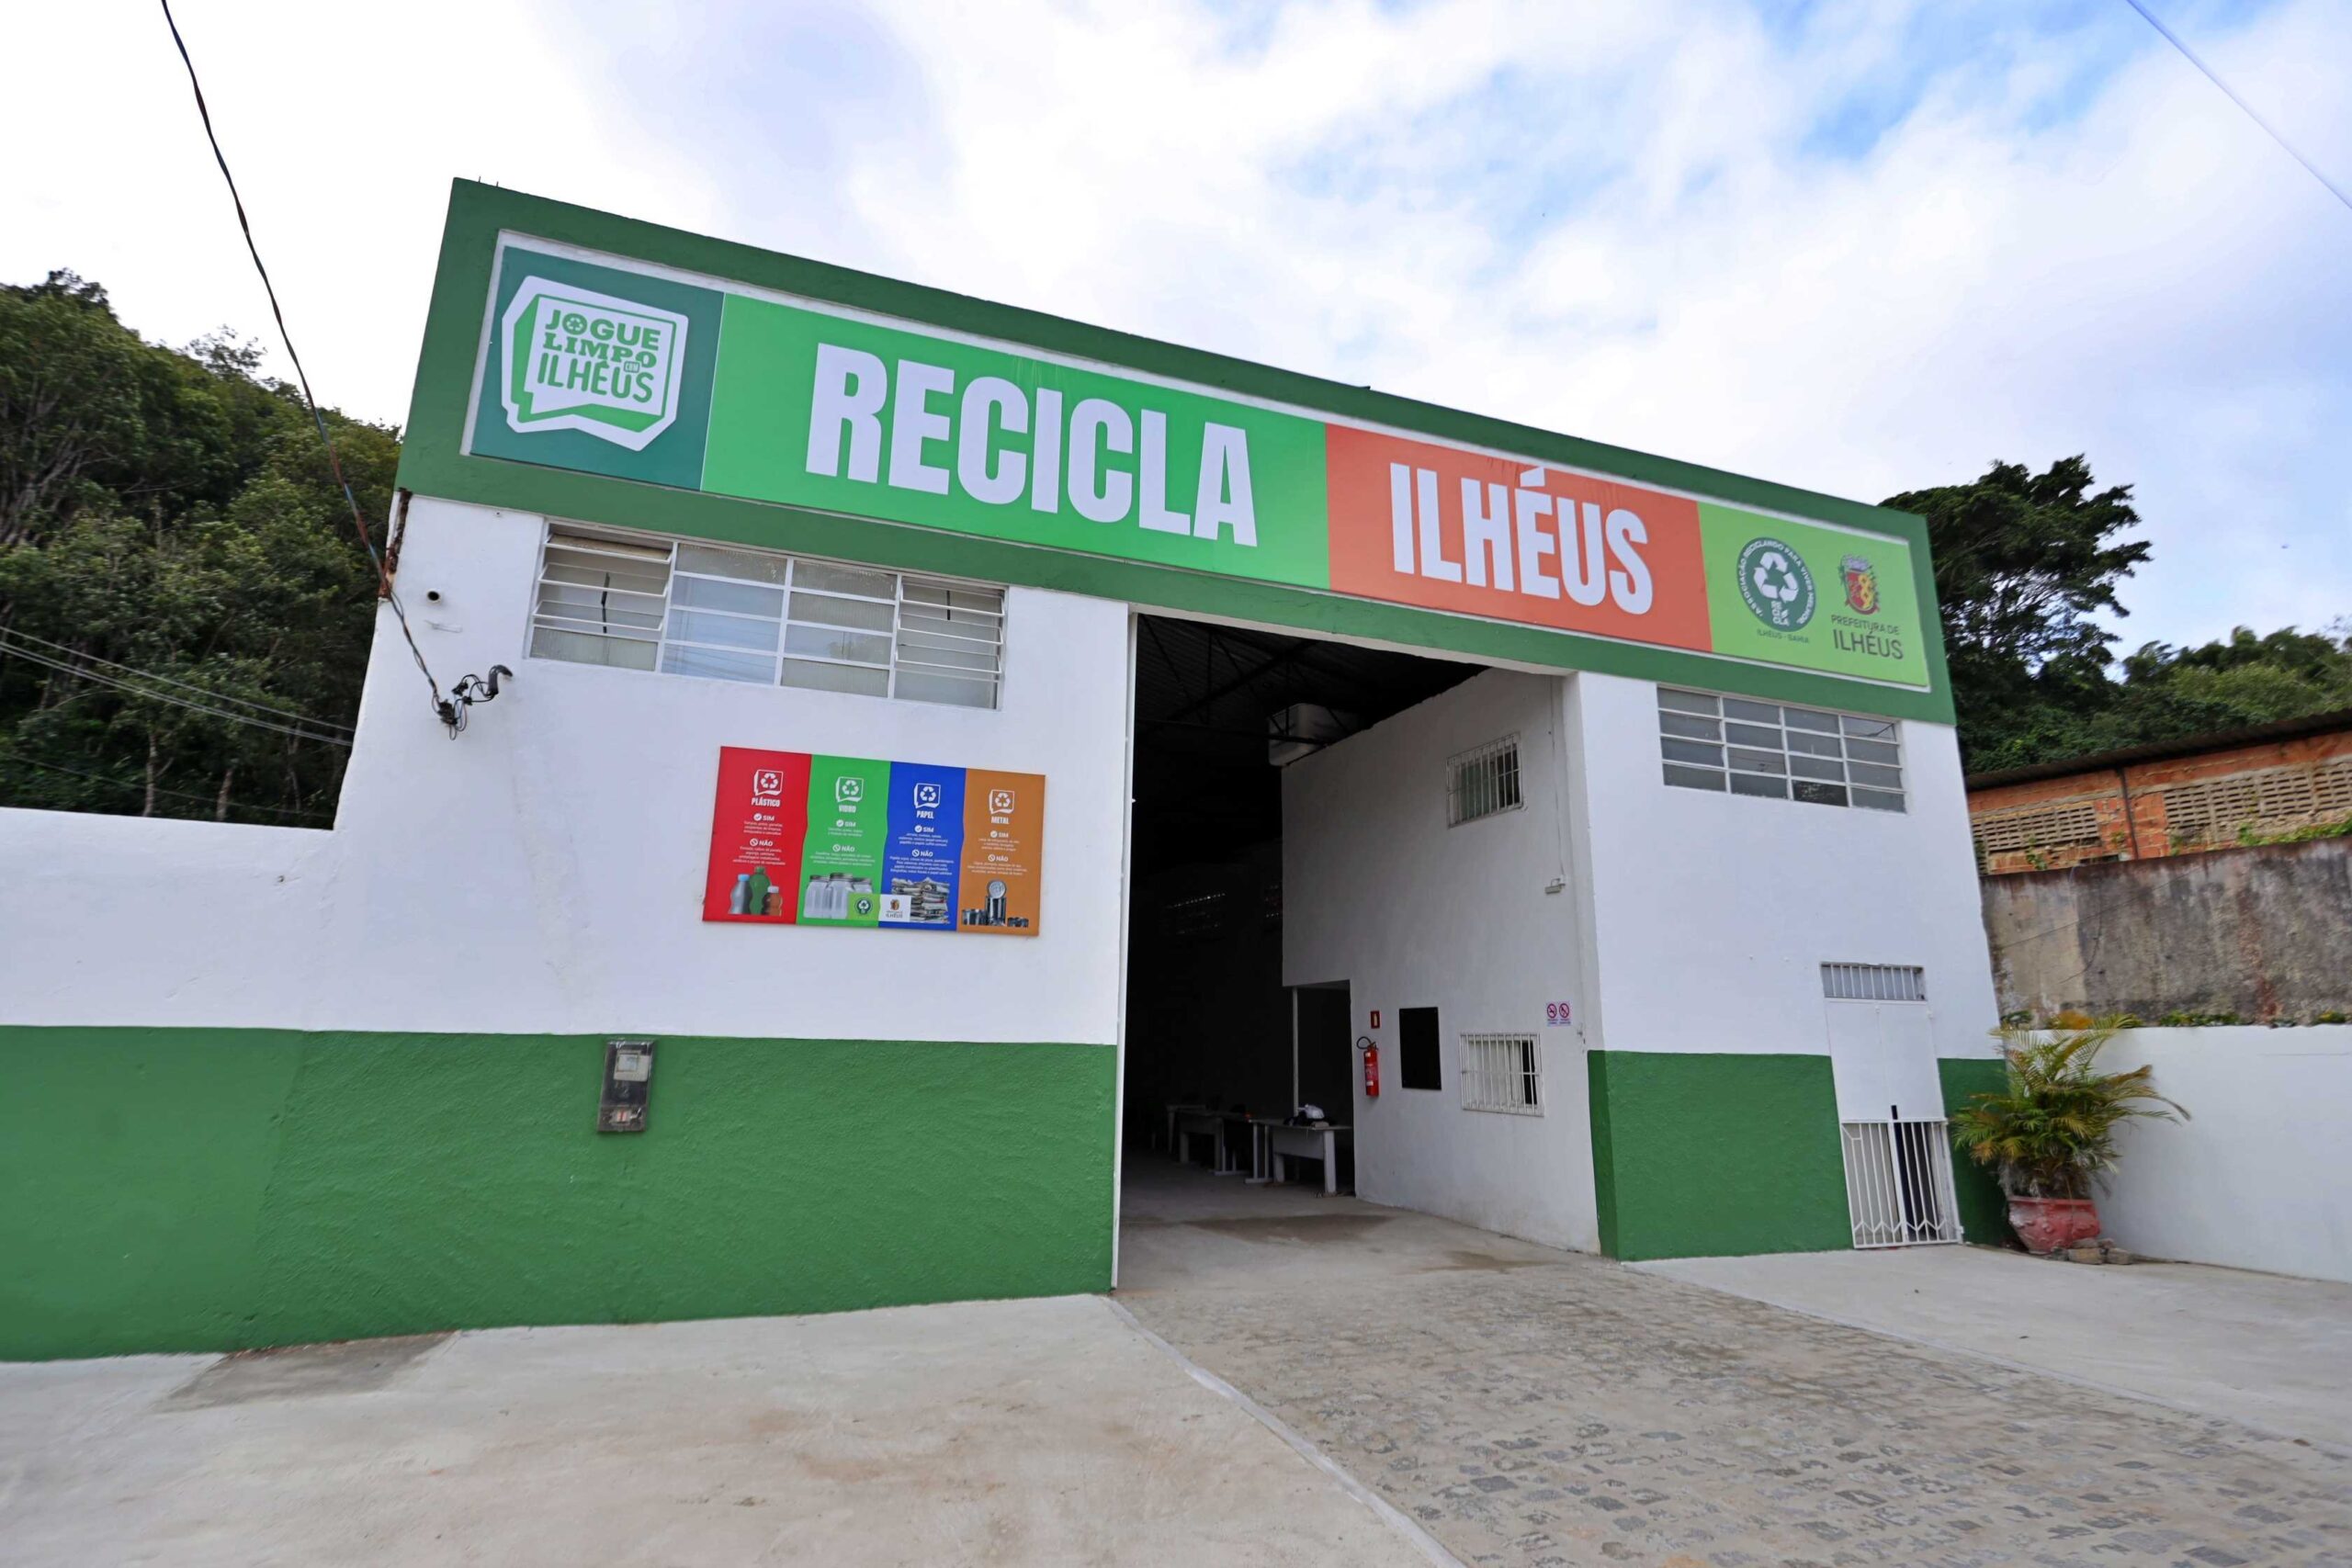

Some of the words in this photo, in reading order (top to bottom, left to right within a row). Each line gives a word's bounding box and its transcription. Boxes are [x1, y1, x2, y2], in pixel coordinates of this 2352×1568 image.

[545, 309, 661, 351] JOGUE
[543, 332, 657, 368] LIMPO
[537, 352, 654, 403] ILHÉUS
[805, 343, 1258, 547] RECICLA
[1390, 462, 1653, 615] ILHÉUS
[1784, 547, 1802, 567] PARA
[1801, 566, 1813, 592] VIVER
[1831, 614, 1885, 632] PREFEITURA
[1887, 625, 1900, 636] DE
[1833, 628, 1904, 660] ILHÉUS
[751, 796, 780, 807] PLÁSTICO
[916, 810, 933, 818] PAPEL
